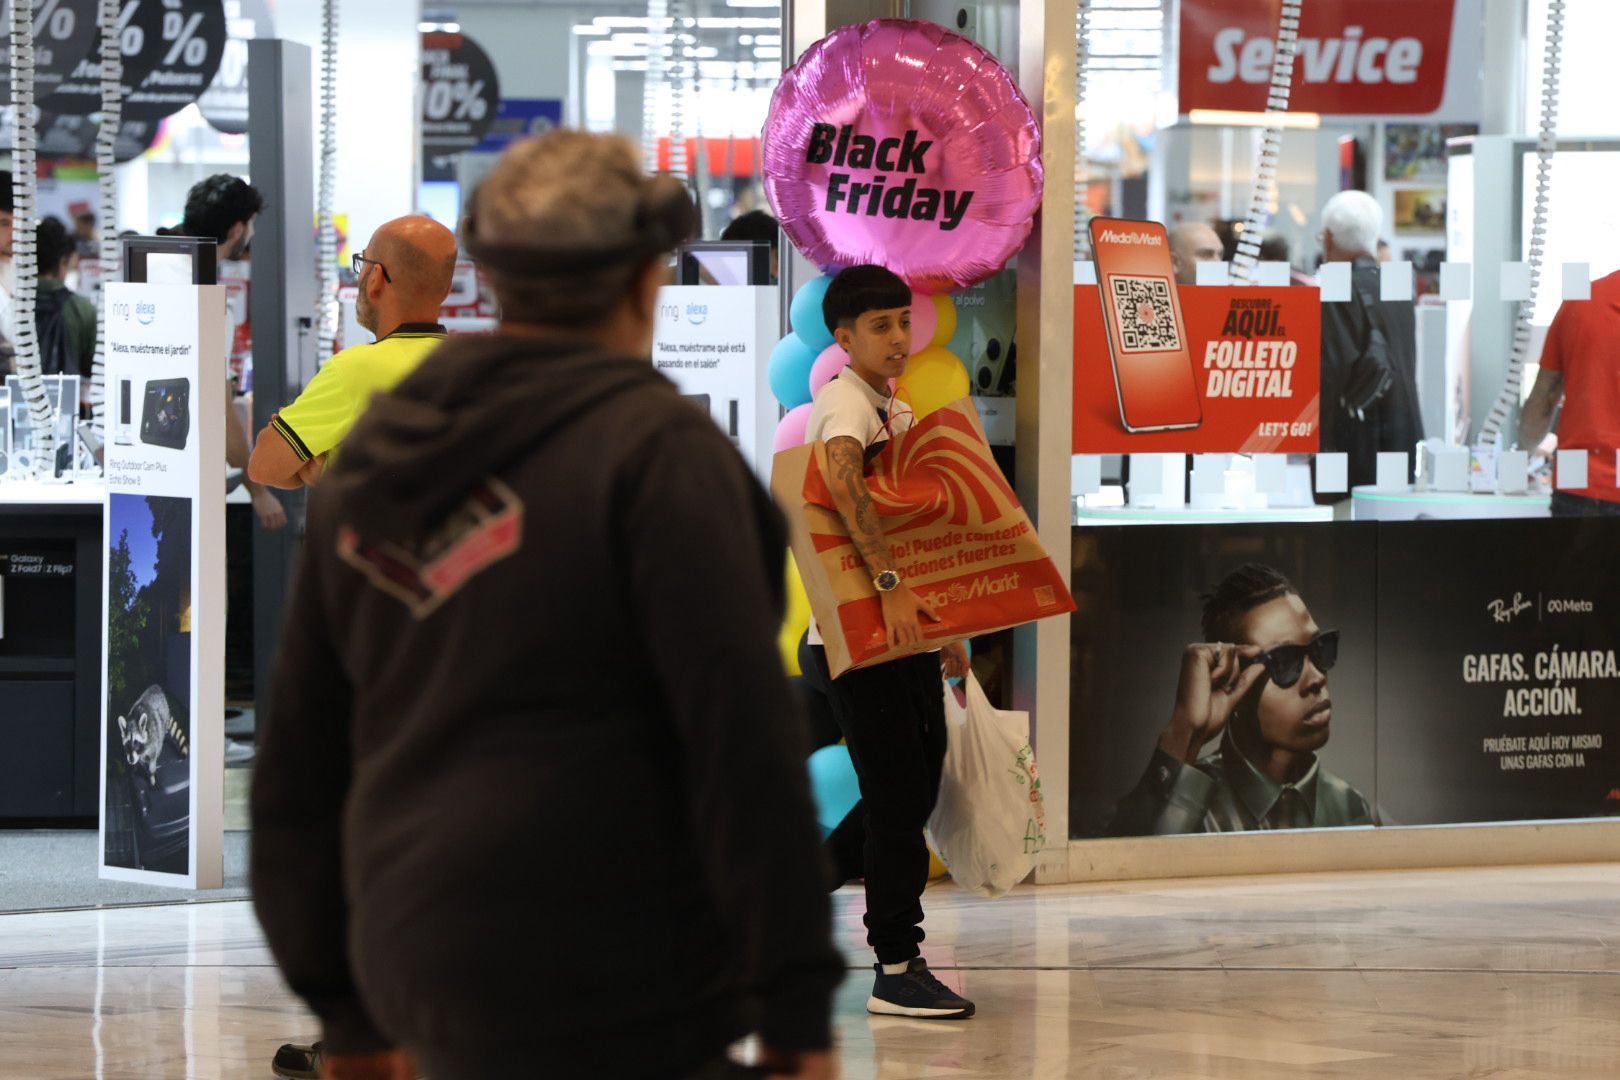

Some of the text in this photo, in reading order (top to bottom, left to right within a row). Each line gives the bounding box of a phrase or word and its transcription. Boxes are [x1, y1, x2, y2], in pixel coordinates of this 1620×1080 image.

[806, 122, 933, 174] Black
[825, 172, 975, 231] Friday
[112, 301, 155, 321] ring alexa
[660, 302, 708, 322] ring alexa
[1222, 304, 1281, 340] AQUÍ
[717, 342, 729, 355] qué
[731, 342, 746, 353] está
[1203, 340, 1297, 369] FOLLETO
[657, 359, 683, 370] pasando
[685, 360, 693, 369] en
[1206, 369, 1292, 398] DIGITAL
[1259, 422, 1312, 437] LET'S GO!
[913, 531, 962, 556] Puede
[966, 521, 1030, 542] contene
[10, 554, 44, 565] Galaxy
[11, 564, 74, 576] Z Fold7 Z Flip7
[897, 543, 1017, 583] ociones fuertes
[968, 571, 1020, 599] Markt
[1563, 600, 1593, 613] Meta
[1463, 643, 1620, 683] GAFAS. CÁMARA.
[1503, 680, 1583, 717] ACCIÓN.
[1483, 733, 1603, 752] PRUÉBATE AQUÍ HOY MISMO
[1500, 752, 1585, 770] UNAS GAFAS CON IA
